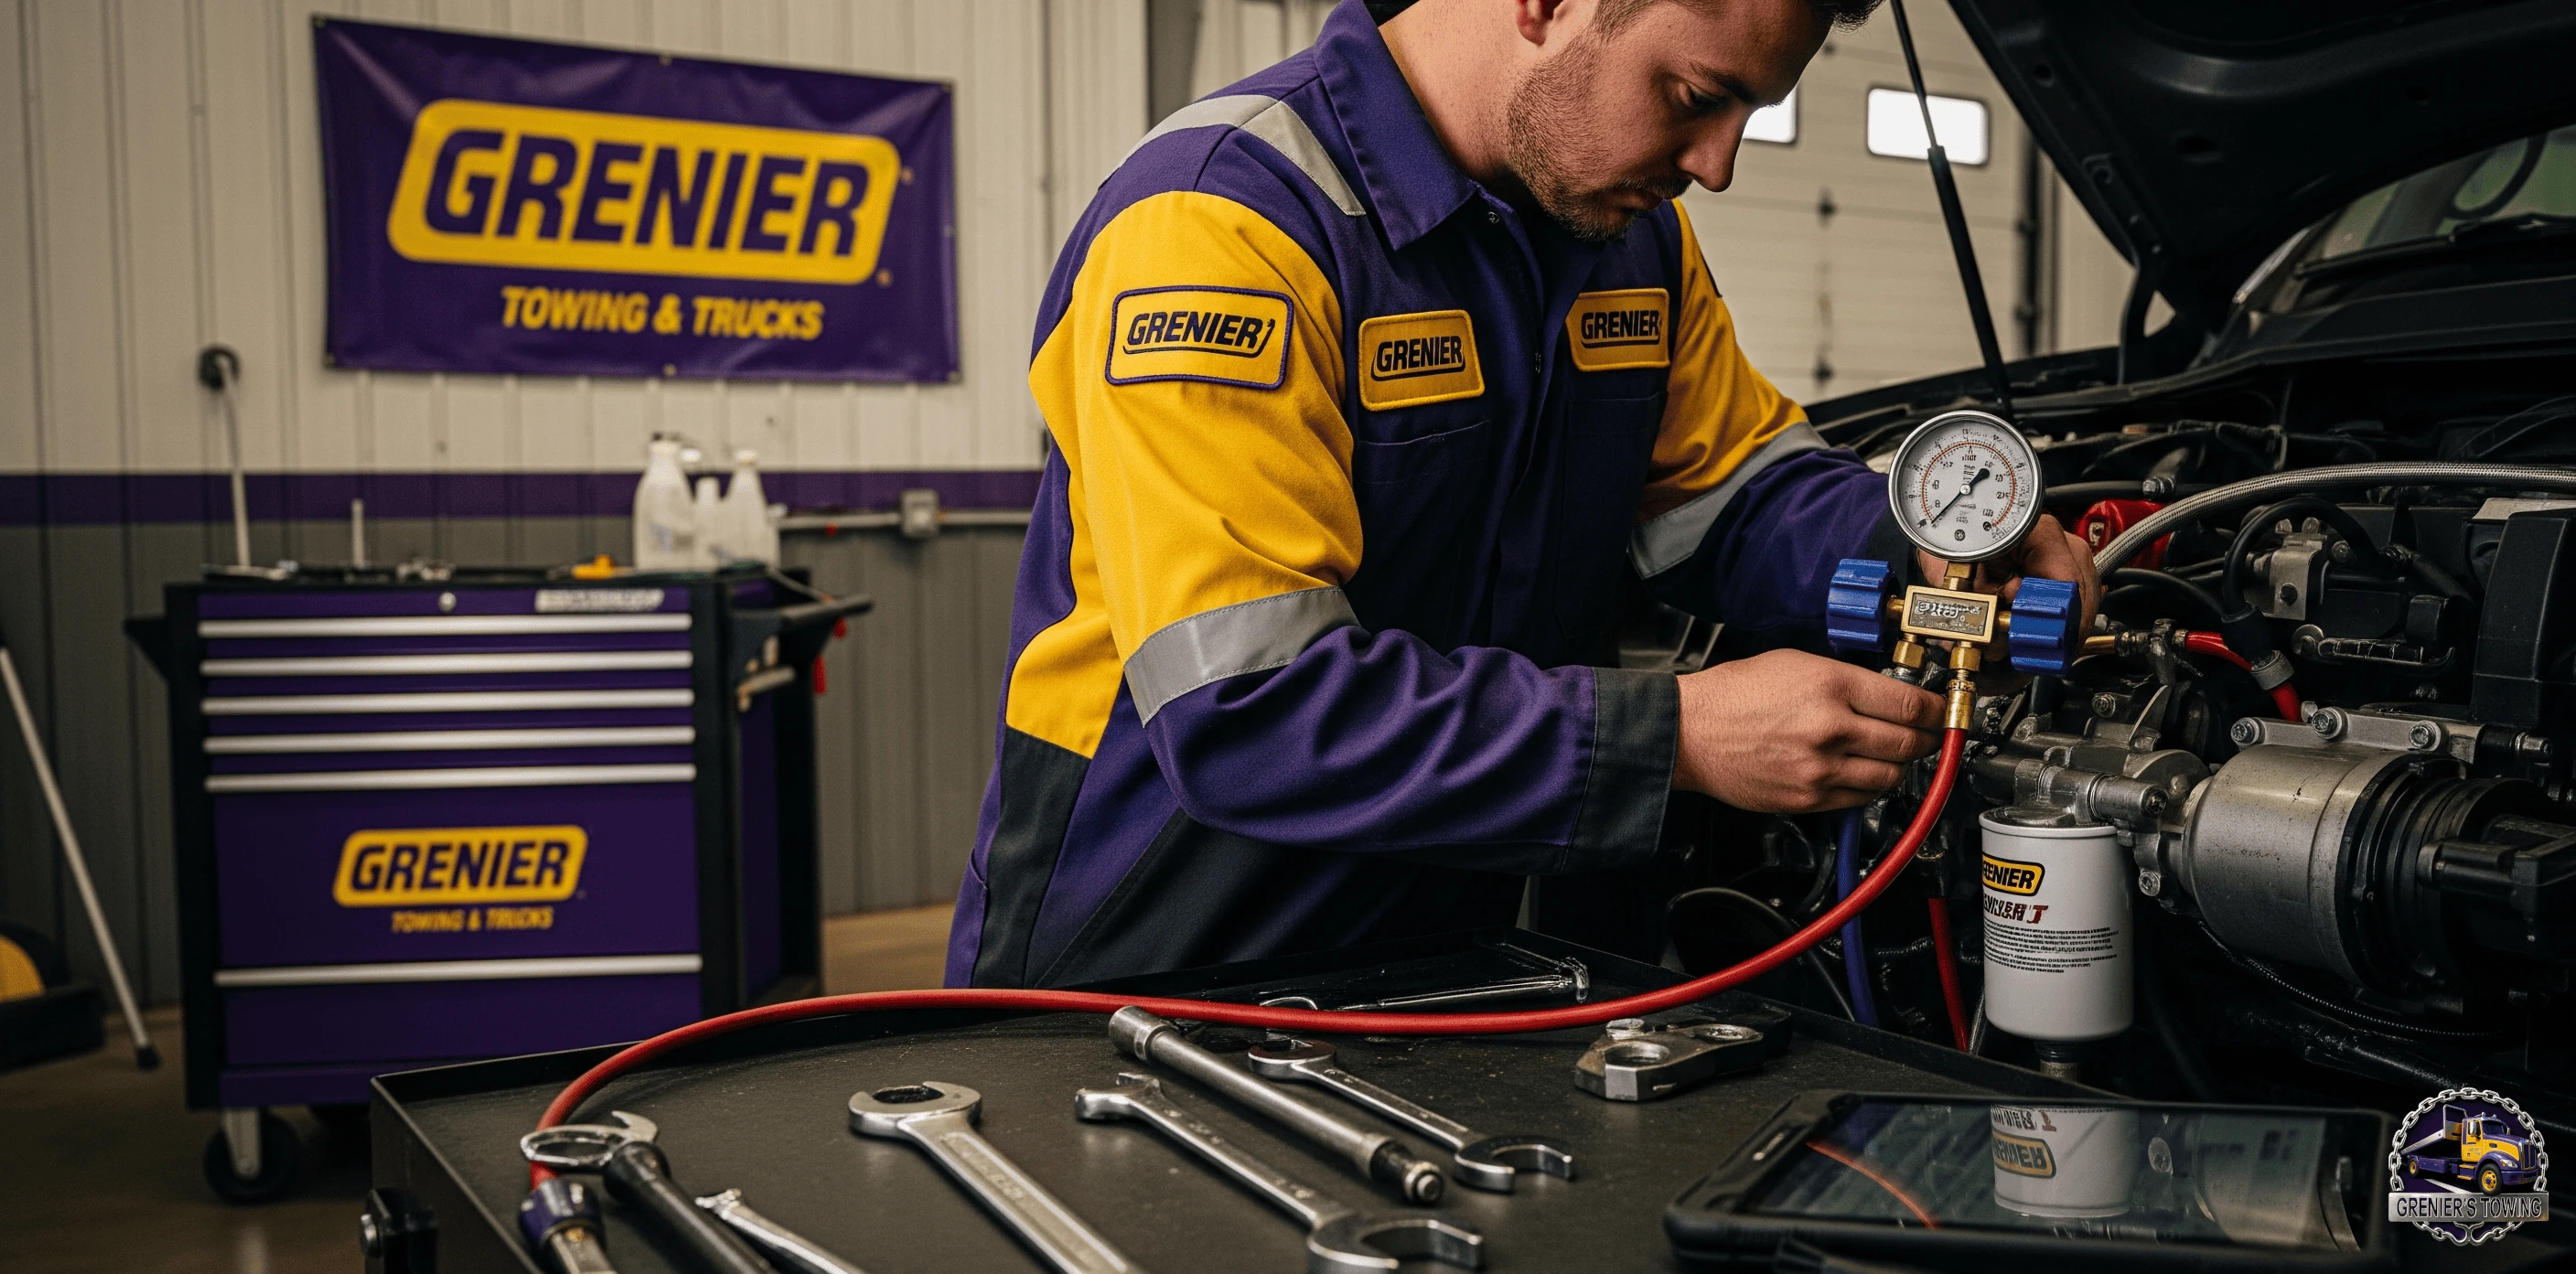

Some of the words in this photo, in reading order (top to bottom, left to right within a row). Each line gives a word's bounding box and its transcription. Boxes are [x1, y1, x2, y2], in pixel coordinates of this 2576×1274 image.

[423, 127, 872, 258] GRENIER
[501, 285, 649, 334] TOWING
[653, 294, 682, 335] &
[692, 295, 825, 341] TRUCKS
[1581, 309, 1660, 340] GRENIER
[1376, 335, 1463, 372] GRENIER
[351, 840, 570, 892] GRENIER
